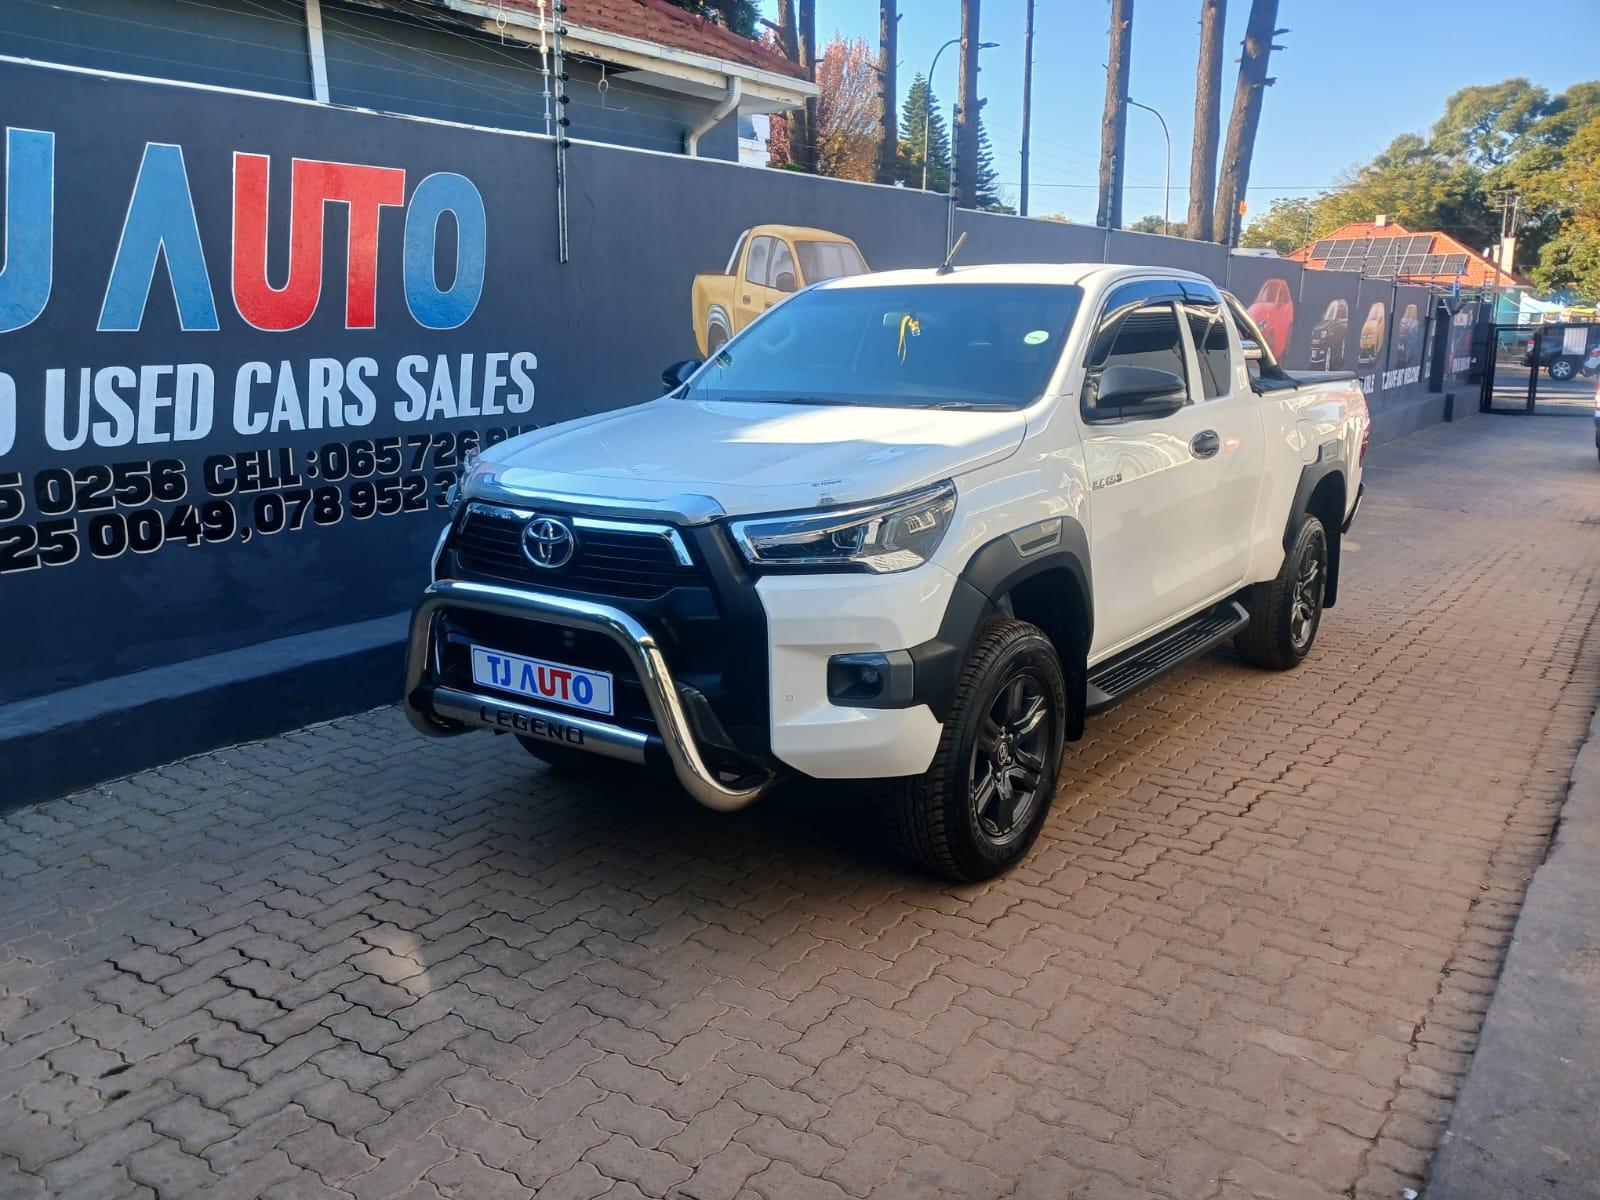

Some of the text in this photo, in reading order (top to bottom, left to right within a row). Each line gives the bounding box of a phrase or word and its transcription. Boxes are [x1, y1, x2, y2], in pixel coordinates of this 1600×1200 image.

[97, 142, 487, 332] AUTO
[45, 363, 215, 451] USED
[233, 357, 379, 435] CARS
[394, 352, 538, 422] SALES
[34, 459, 188, 515] 0256
[350, 474, 429, 520] 952
[487, 655, 594, 705] TJ AUTO
[480, 705, 585, 746] LEGEND
